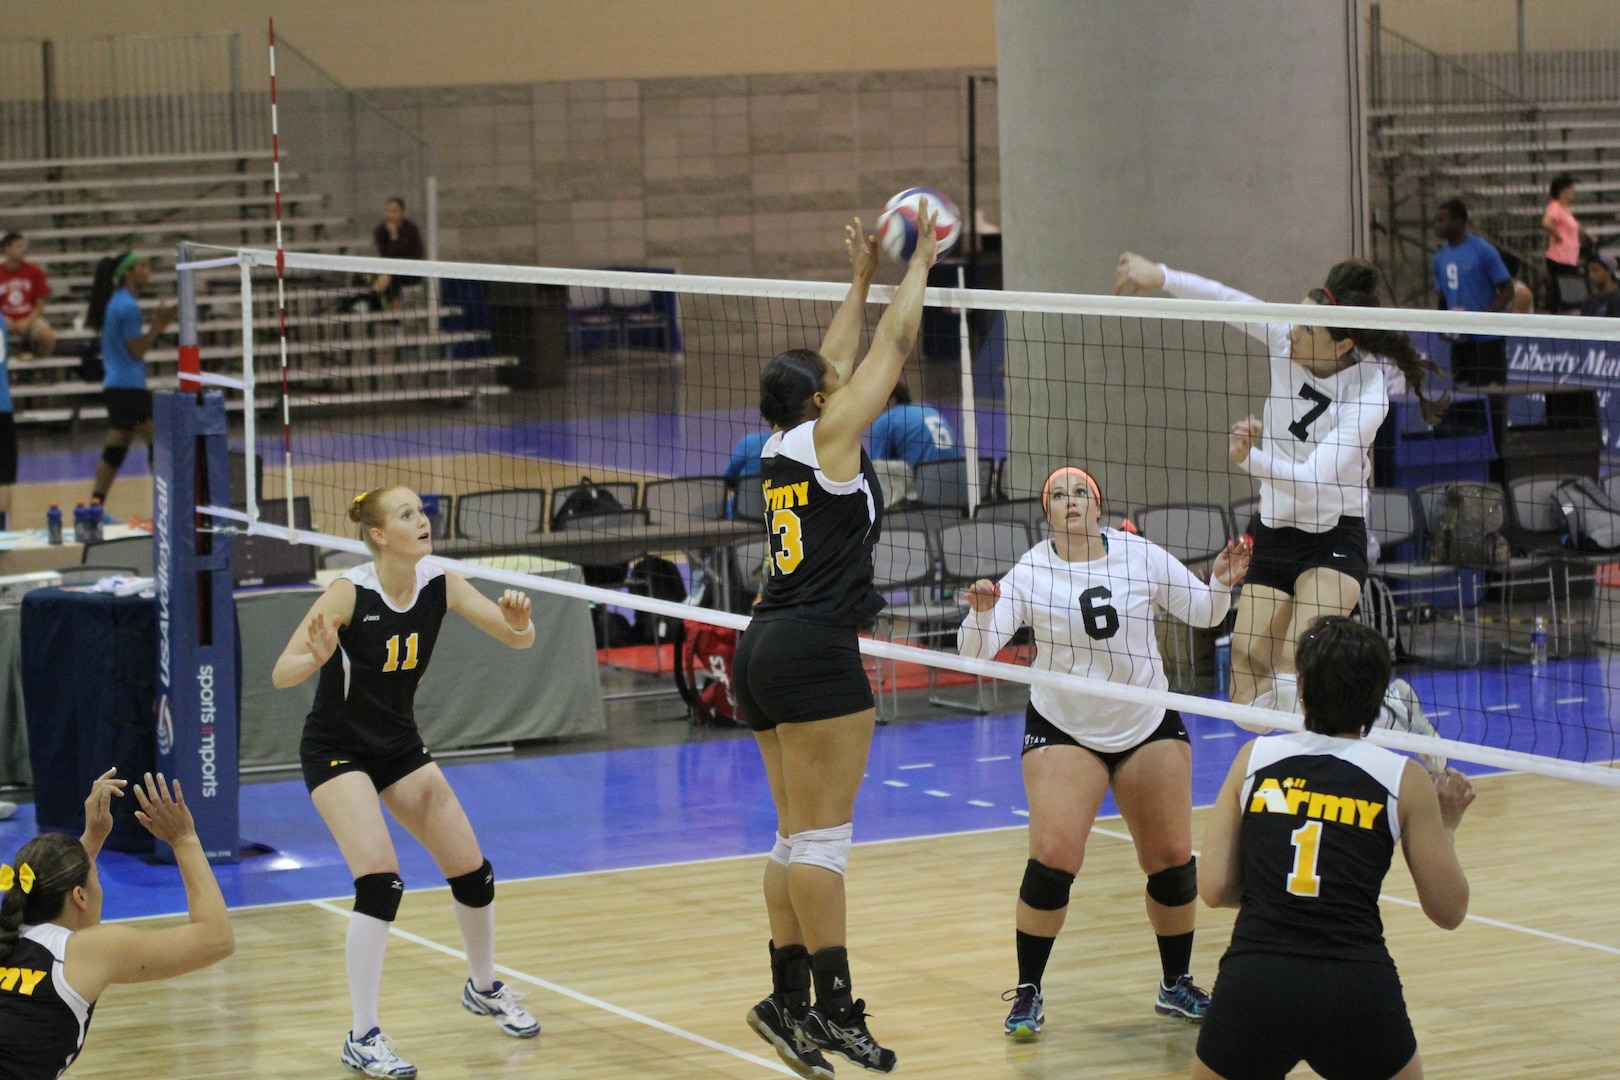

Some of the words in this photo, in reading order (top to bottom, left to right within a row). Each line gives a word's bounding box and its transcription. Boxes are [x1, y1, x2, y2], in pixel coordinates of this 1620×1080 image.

[1446, 263, 1458, 289] 9
[1509, 344, 1580, 384] Liberty
[924, 416, 953, 449] 6
[1288, 382, 1332, 443] 7
[762, 481, 809, 512] rmy
[1079, 585, 1119, 640] 6
[382, 632, 418, 672] 11
[197, 665, 217, 723] sports
[1286, 820, 1323, 897] 1
